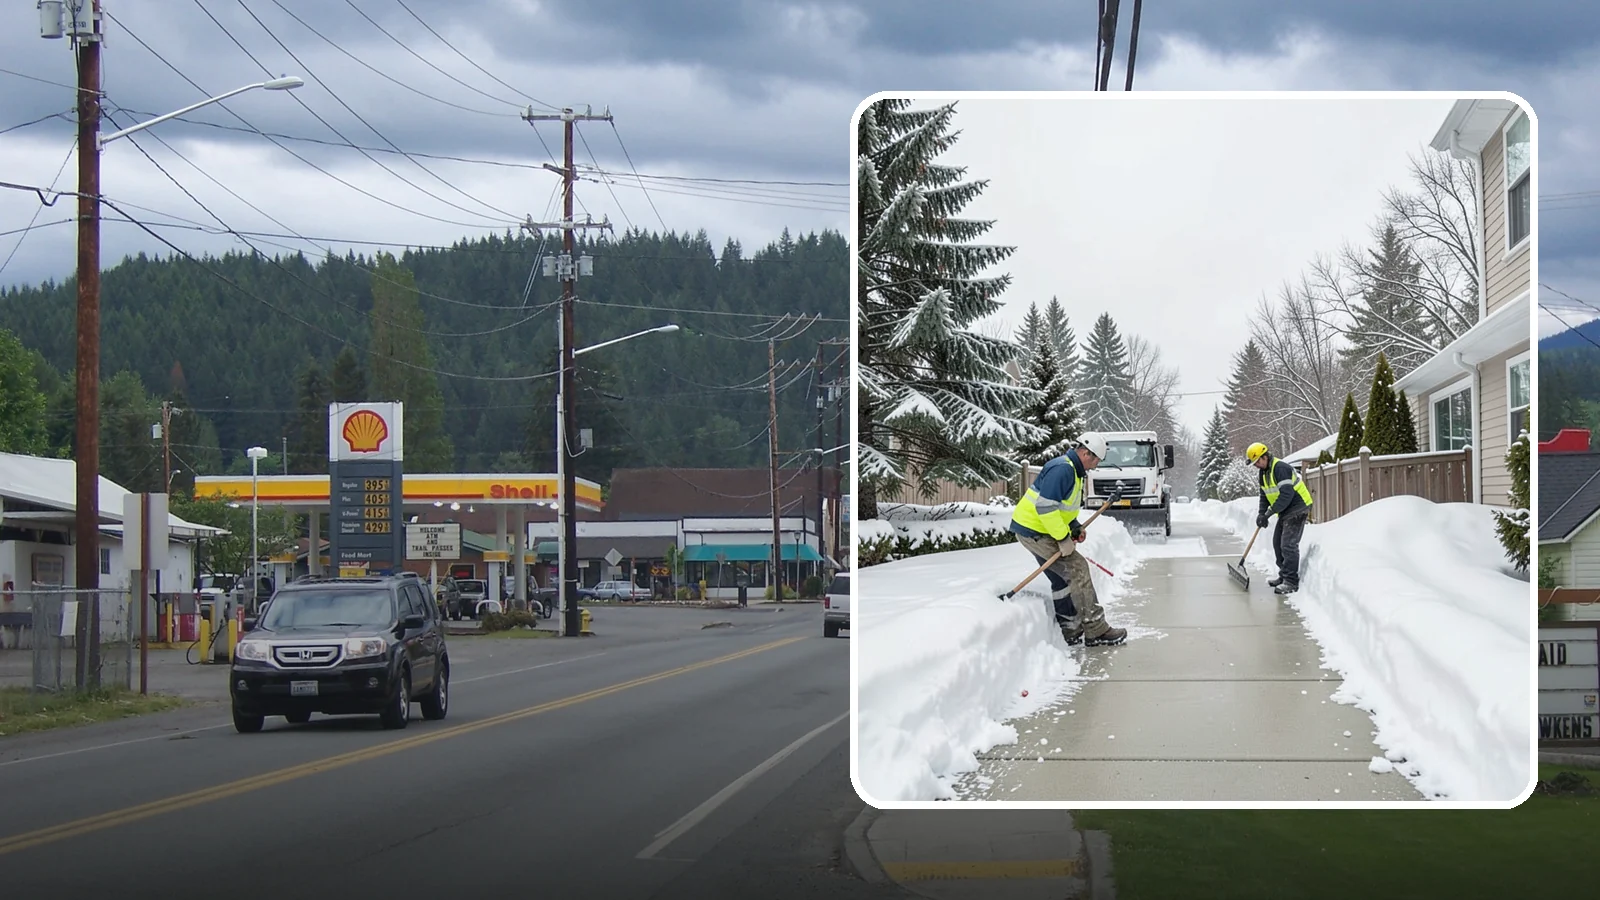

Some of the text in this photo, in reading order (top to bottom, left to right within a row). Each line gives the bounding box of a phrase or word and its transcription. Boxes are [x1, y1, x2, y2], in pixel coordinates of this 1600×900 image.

[366, 480, 383, 490] 395
[490, 484, 547, 499] Shell
[366, 494, 383, 504] 405
[366, 508, 383, 518] 415
[366, 522, 383, 532] 429
